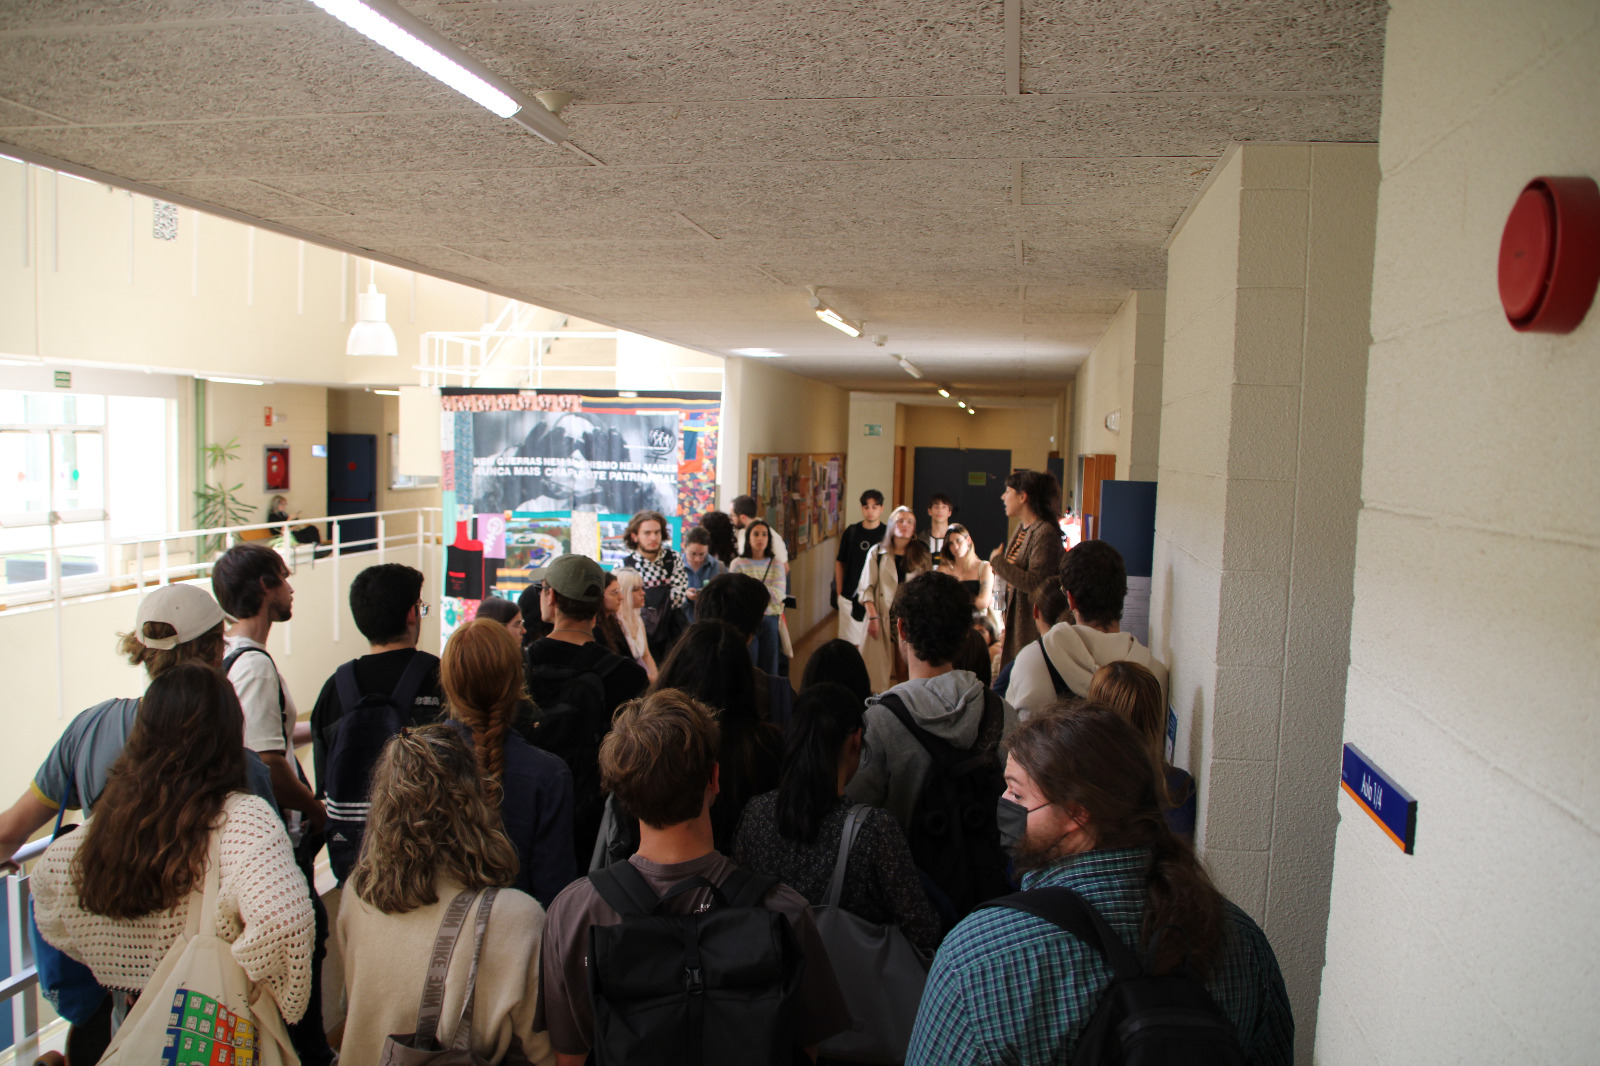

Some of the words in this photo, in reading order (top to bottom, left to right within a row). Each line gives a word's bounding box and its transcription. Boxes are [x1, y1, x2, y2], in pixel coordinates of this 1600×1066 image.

[473, 466, 512, 477] NUNCA
[513, 467, 542, 477] MAIS
[496, 457, 543, 466] GUERRAS
[566, 458, 618, 470] MHISMO
[443, 896, 473, 928] NIKE
[431, 935, 455, 969] NIKE
[422, 975, 446, 1009] NIKE
